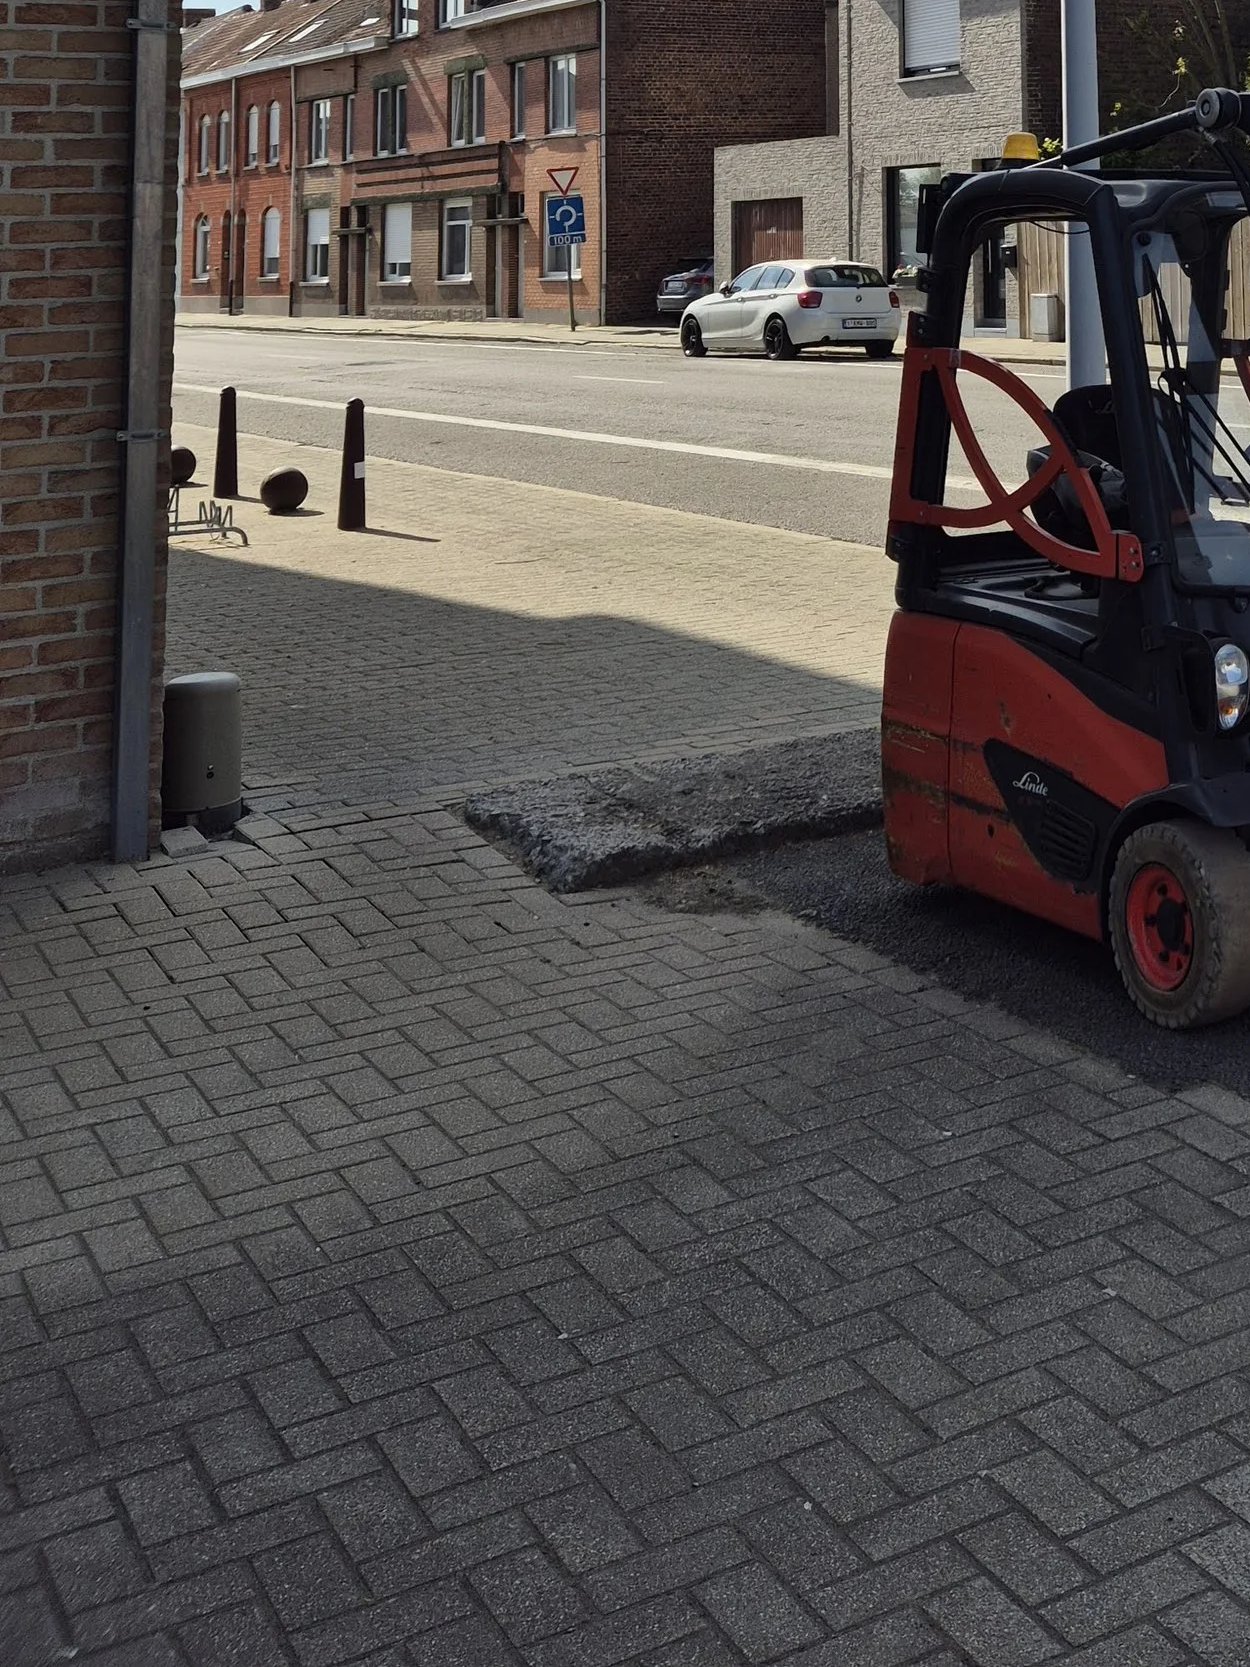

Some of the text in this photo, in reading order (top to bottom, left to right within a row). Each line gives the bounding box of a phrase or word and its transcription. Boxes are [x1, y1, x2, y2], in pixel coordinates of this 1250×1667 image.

[553, 235, 583, 245] 100 m
[1012, 771, 1049, 797] Linde
